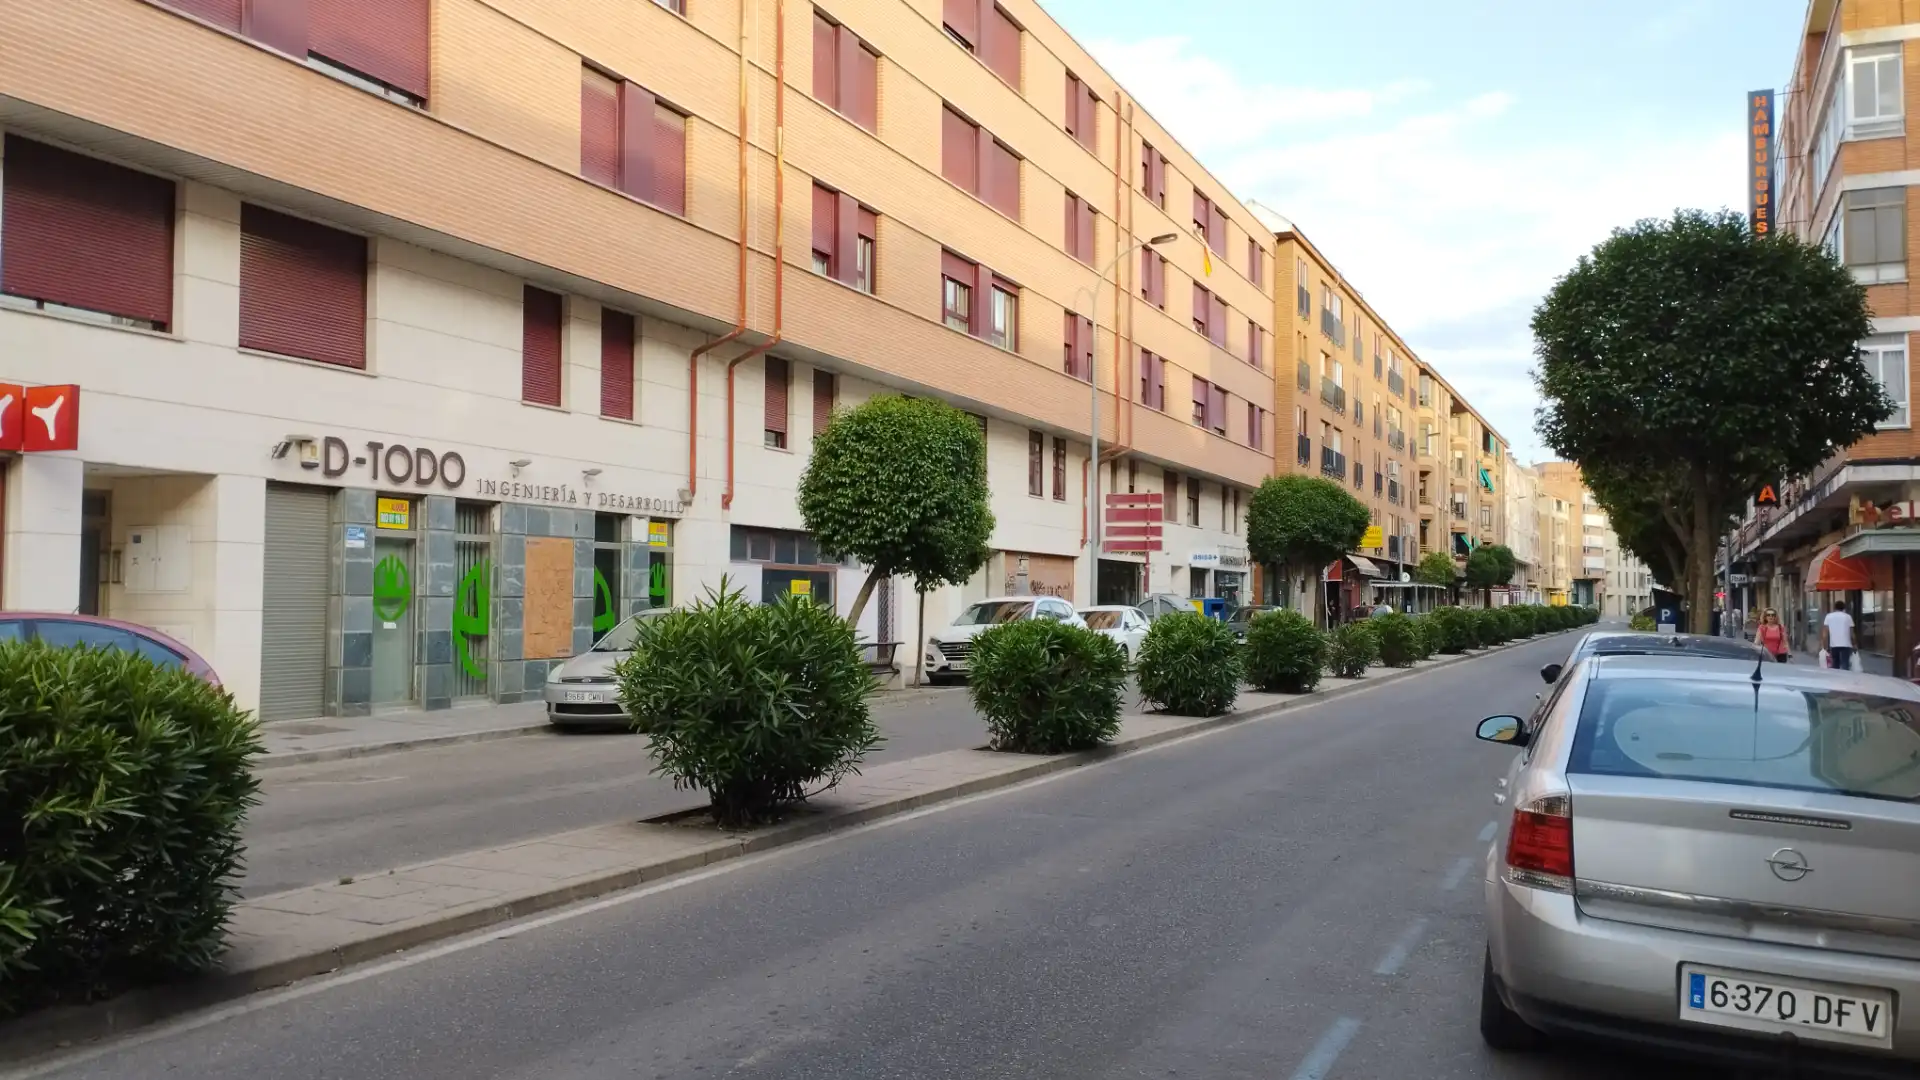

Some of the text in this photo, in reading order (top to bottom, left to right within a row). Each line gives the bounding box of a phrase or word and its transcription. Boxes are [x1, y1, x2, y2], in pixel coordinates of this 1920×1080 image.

[1752, 95, 1769, 241] HAMBURGUES
[323, 436, 466, 489] D-TODO
[476, 478, 685, 514] INGENIERÍA Y DESARROLLO
[1661, 608, 1671, 621] P
[1710, 980, 1880, 1033] 6370 DFV
